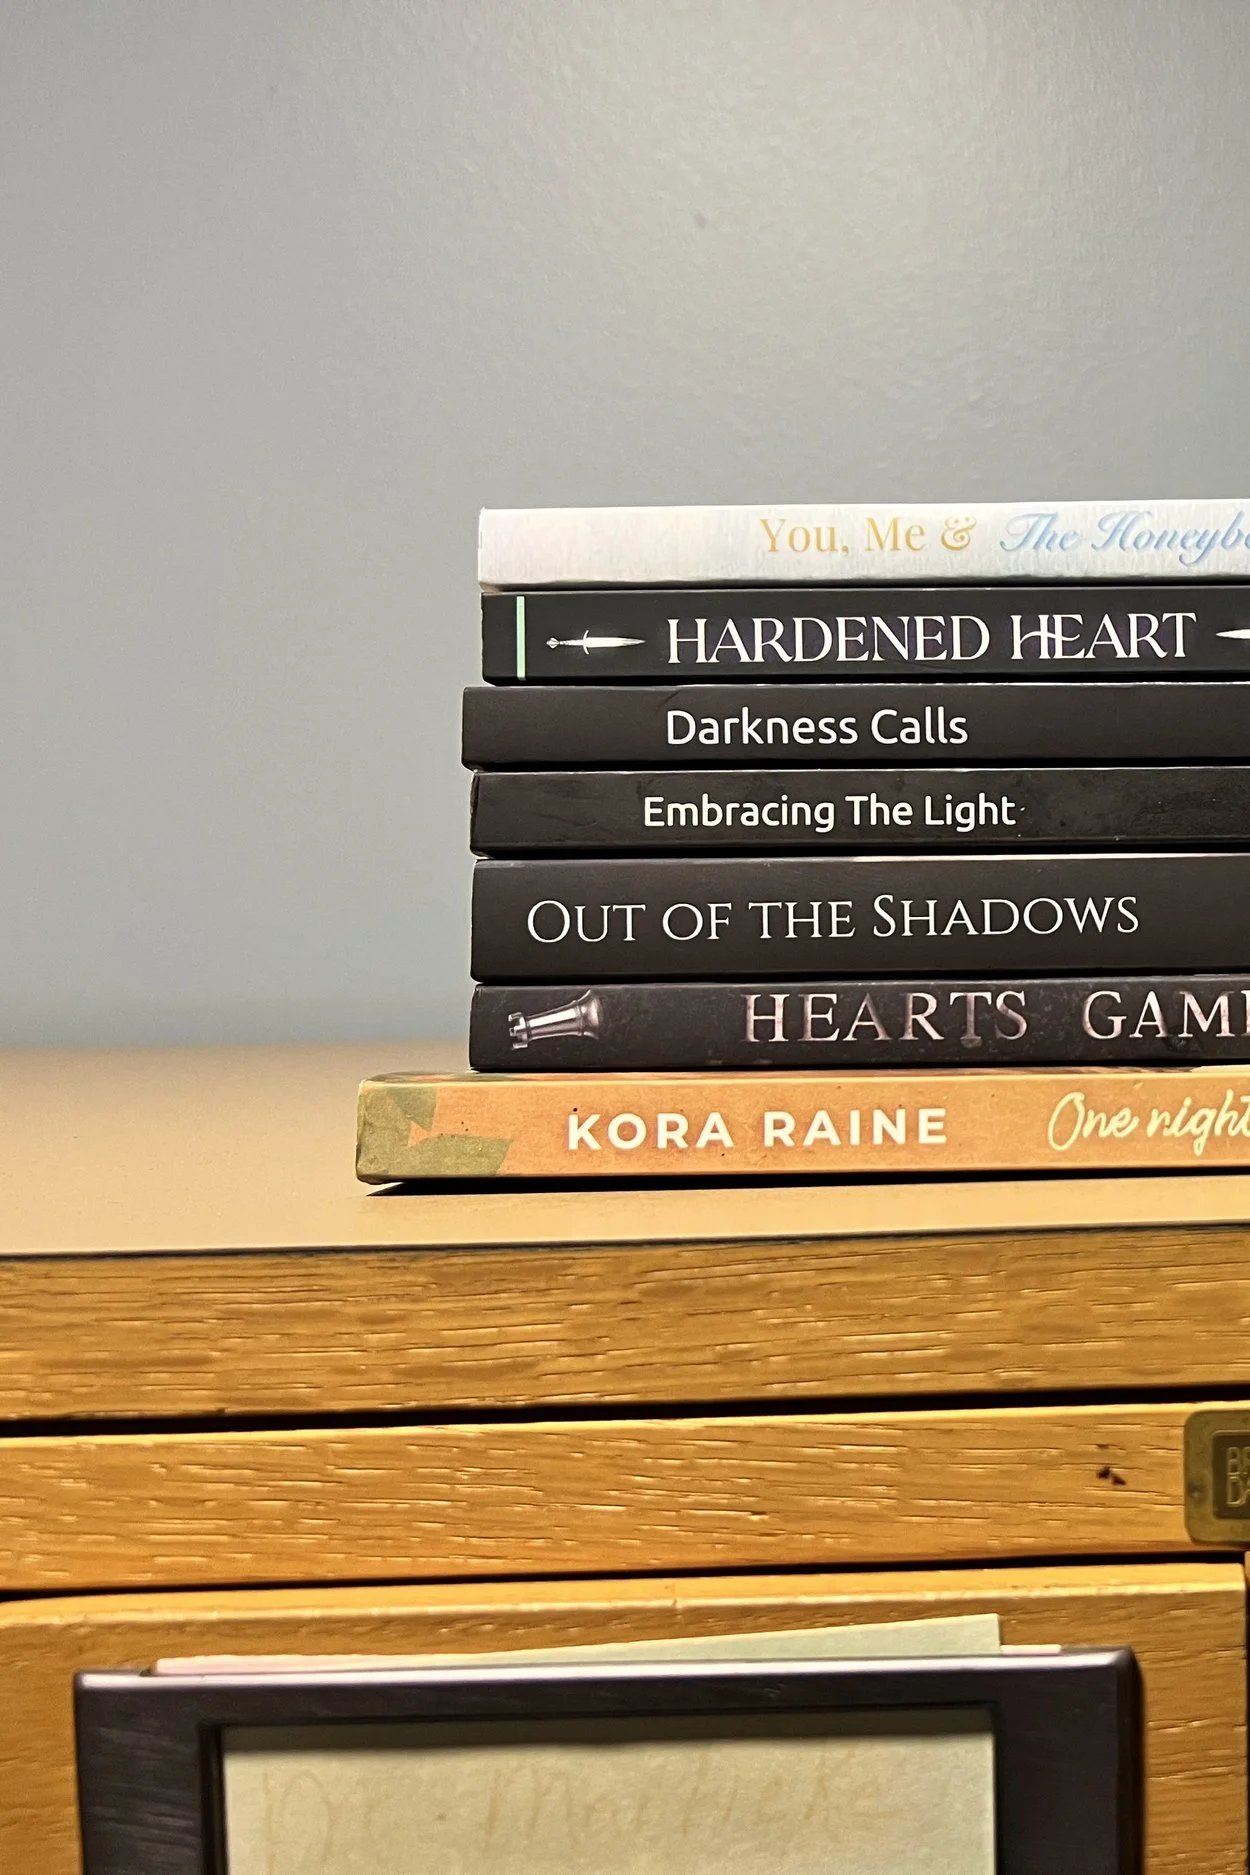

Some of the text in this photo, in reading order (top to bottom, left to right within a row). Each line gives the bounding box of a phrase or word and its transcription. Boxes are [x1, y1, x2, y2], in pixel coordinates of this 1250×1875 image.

[760, 517, 850, 556] You,
[864, 516, 926, 553] Me
[940, 515, 977, 552] &
[1000, 511, 1080, 553] The
[667, 612, 1197, 664] HARDENED HEART
[667, 705, 968, 745] Darkness Calls
[644, 792, 1017, 833] Embracing The Light
[527, 894, 1140, 943] OUT OF THE SHADOWS
[743, 991, 1028, 1043] HEARTS
[568, 1107, 947, 1151] KORA RAINE
[1048, 1091, 1139, 1152] One
